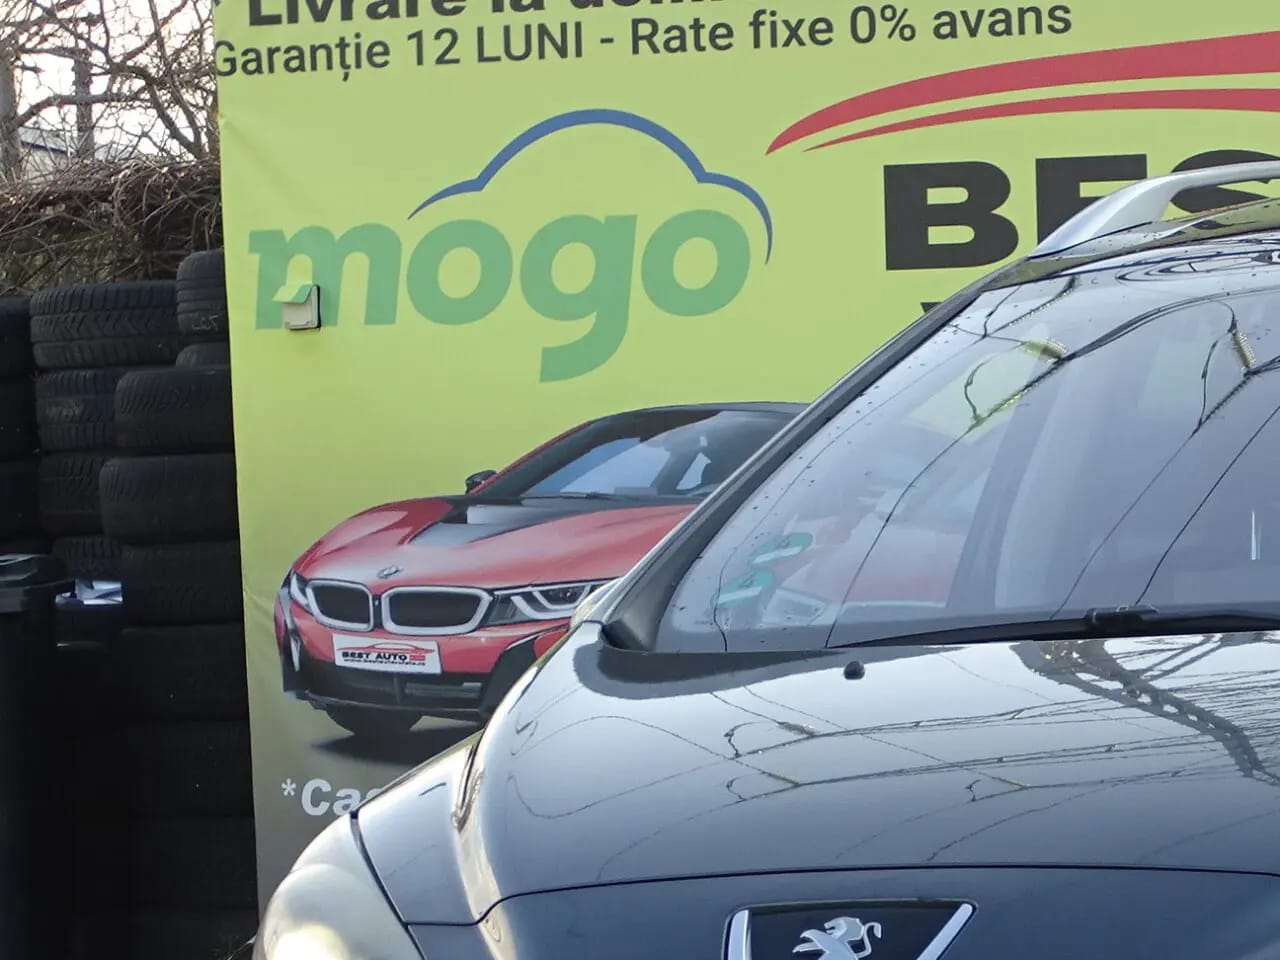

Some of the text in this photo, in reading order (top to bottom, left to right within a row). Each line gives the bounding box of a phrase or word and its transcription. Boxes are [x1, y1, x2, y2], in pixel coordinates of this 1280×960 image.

[407, 27, 461, 66] 12
[477, 22, 583, 63] LUNI
[631, 17, 734, 55] Rate
[749, 8, 834, 49] fixe
[850, 4, 916, 42] 0%
[932, 5, 1072, 40] avans
[247, 208, 751, 383] mogo
